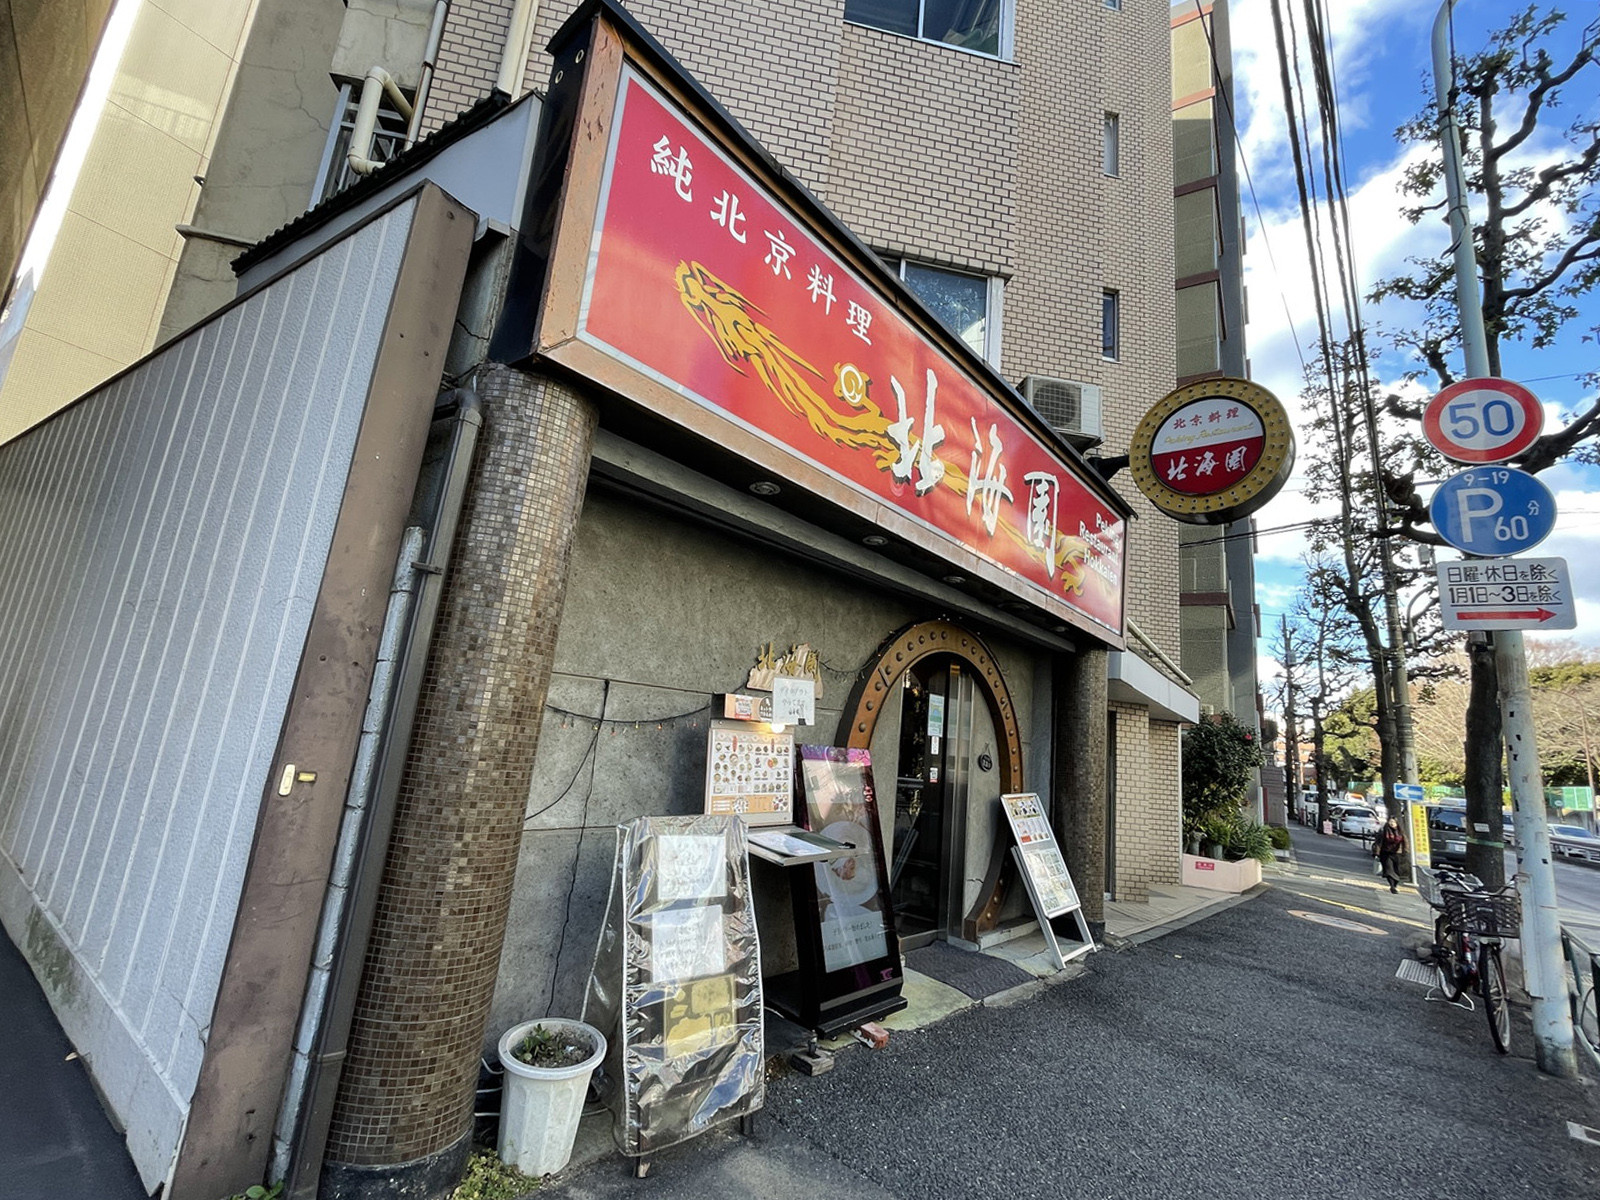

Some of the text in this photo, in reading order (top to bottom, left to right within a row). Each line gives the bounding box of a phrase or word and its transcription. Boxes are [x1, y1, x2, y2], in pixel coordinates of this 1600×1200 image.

[650, 135, 873, 346] 純北京料理
[1173, 406, 1240, 430] 北京料理
[1449, 400, 1515, 439] 50
[887, 368, 1060, 579] 北海園
[1167, 446, 1247, 481] 北海園
[1463, 471, 1510, 486] 9-19
[1456, 487, 1504, 543] P
[1447, 564, 1557, 584] 日曜・休日を除く
